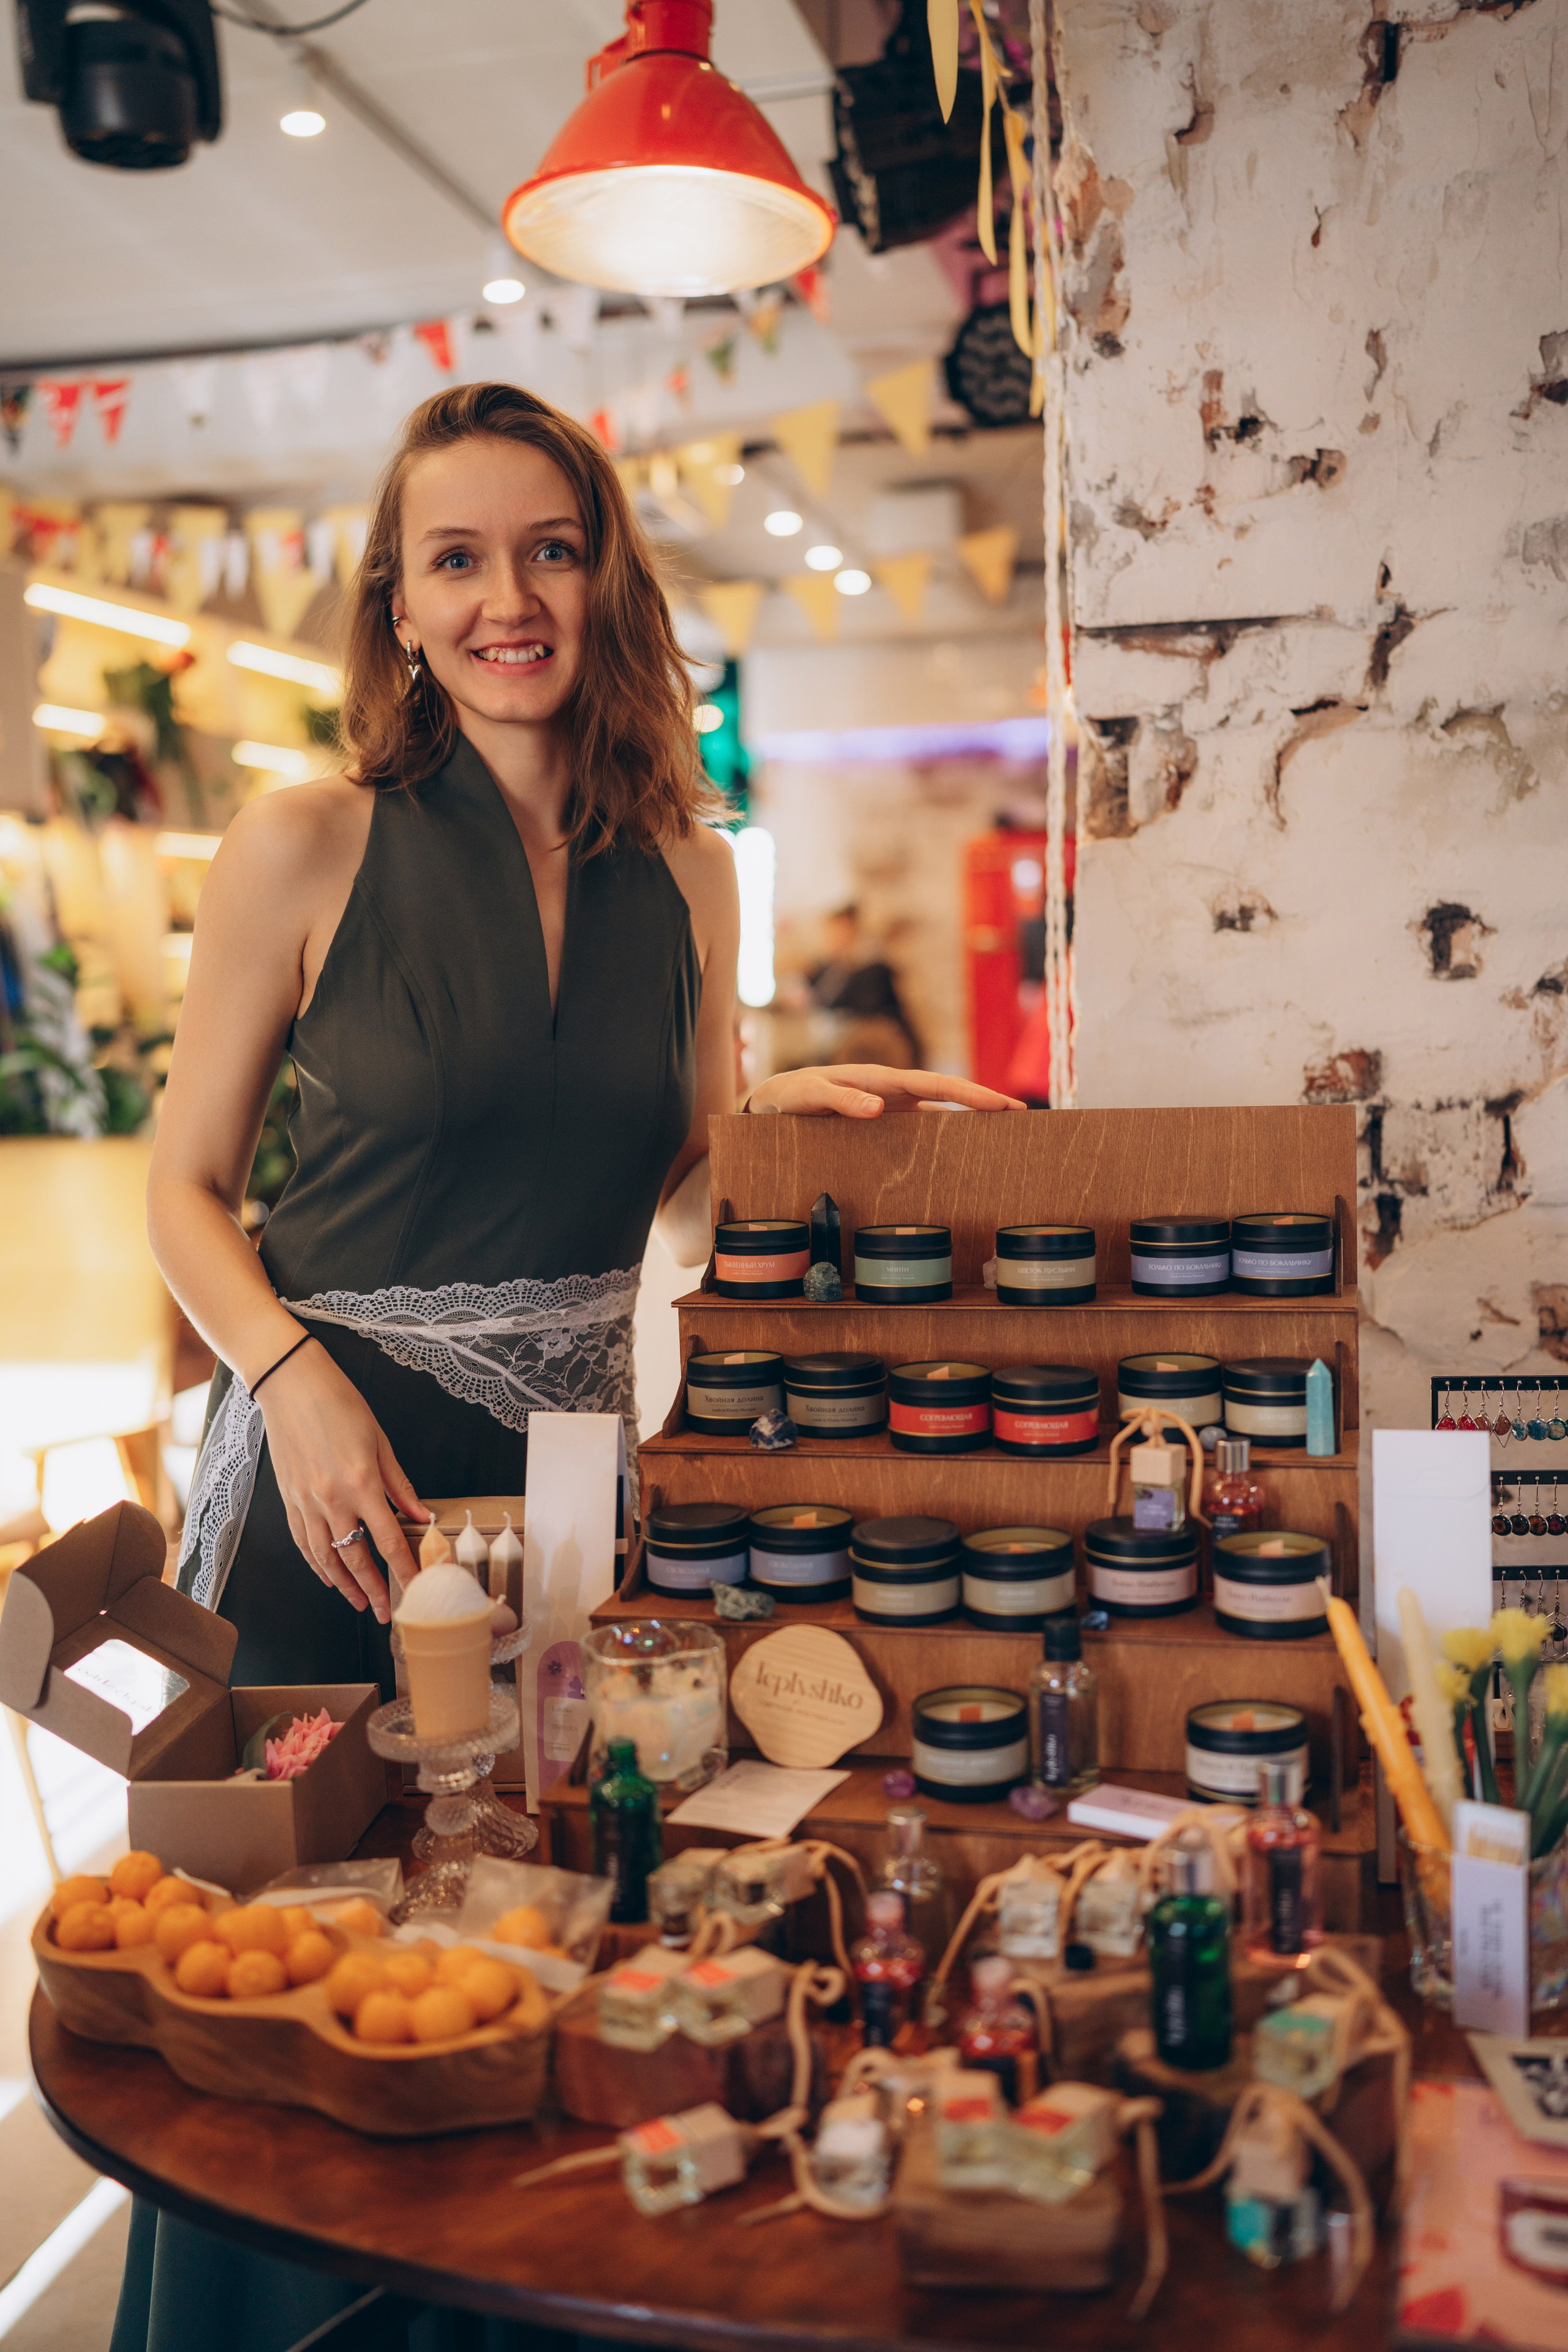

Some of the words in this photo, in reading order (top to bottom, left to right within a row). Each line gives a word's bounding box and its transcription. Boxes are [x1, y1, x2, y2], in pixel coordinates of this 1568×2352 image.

[1186, 1262, 1223, 1271] БОКАЛЬЧИКУ
[705, 1395, 734, 1403] Хвойная
[805, 1404, 836, 1413] Хвойная
